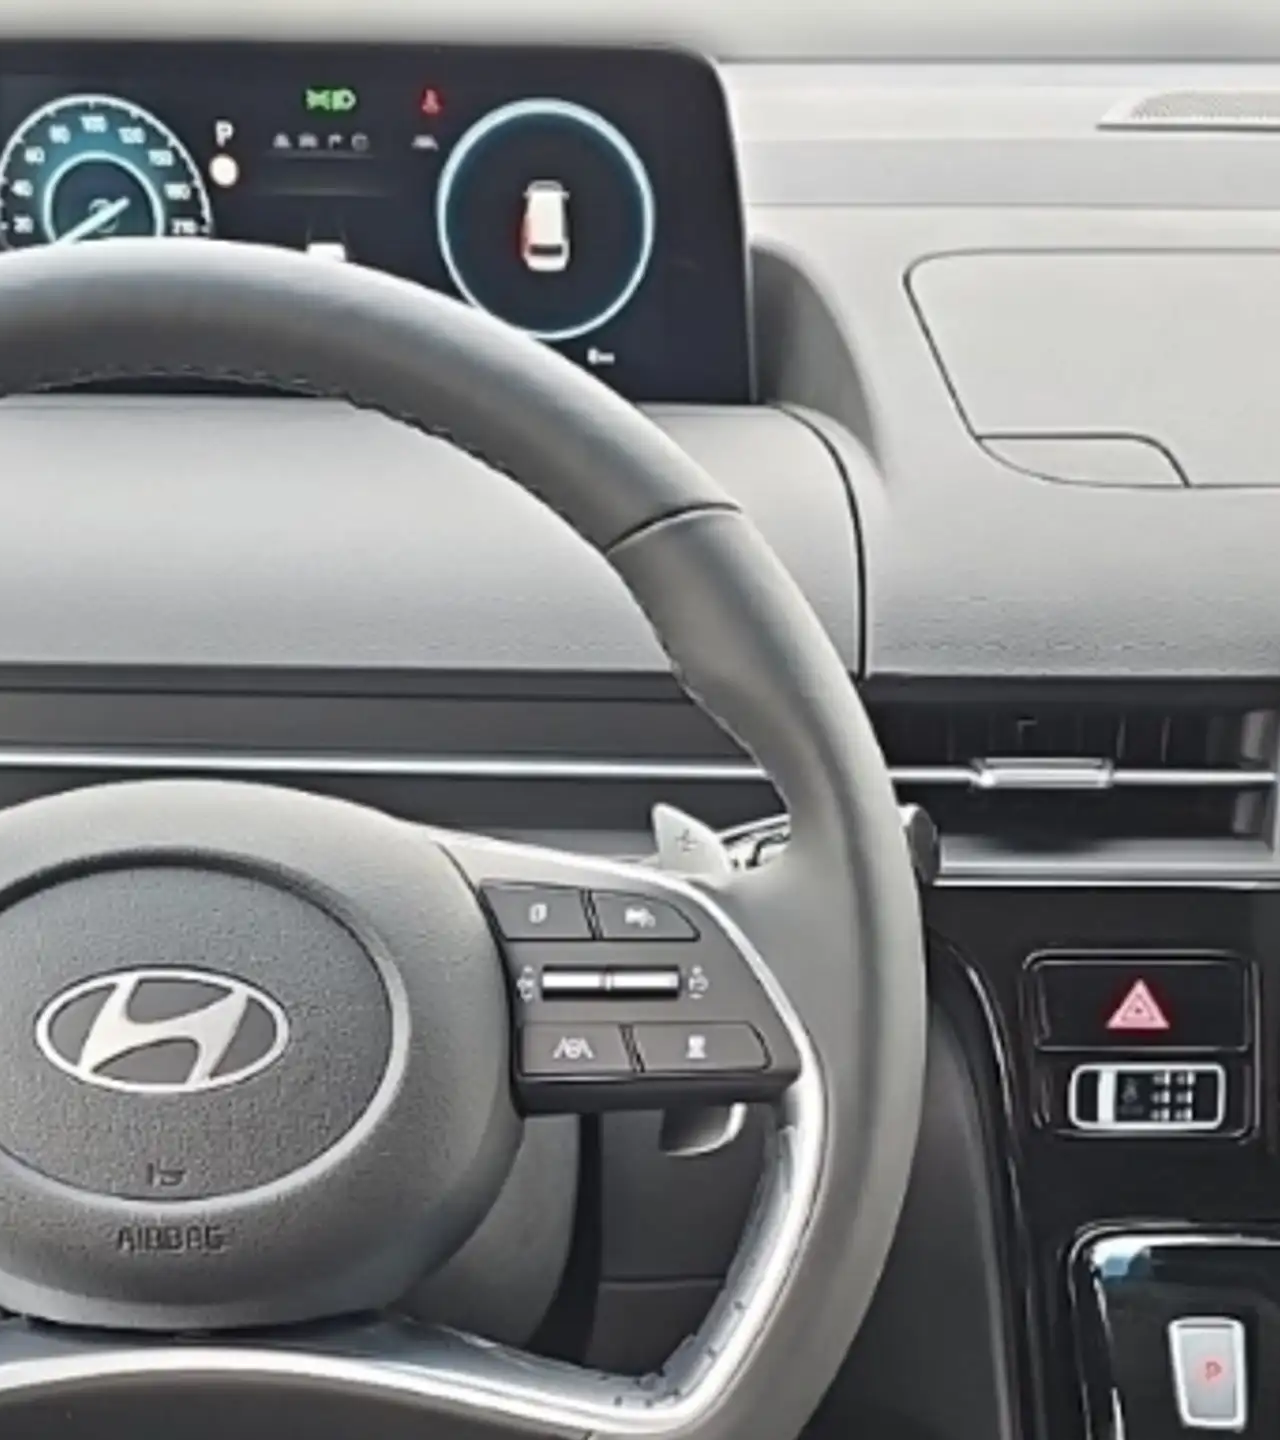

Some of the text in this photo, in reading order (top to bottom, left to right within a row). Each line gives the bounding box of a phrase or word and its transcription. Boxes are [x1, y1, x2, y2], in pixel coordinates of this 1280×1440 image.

[215, 119, 234, 147] P
[116, 1225, 226, 1252] AIRBAG
[1204, 1360, 1223, 1381] P
